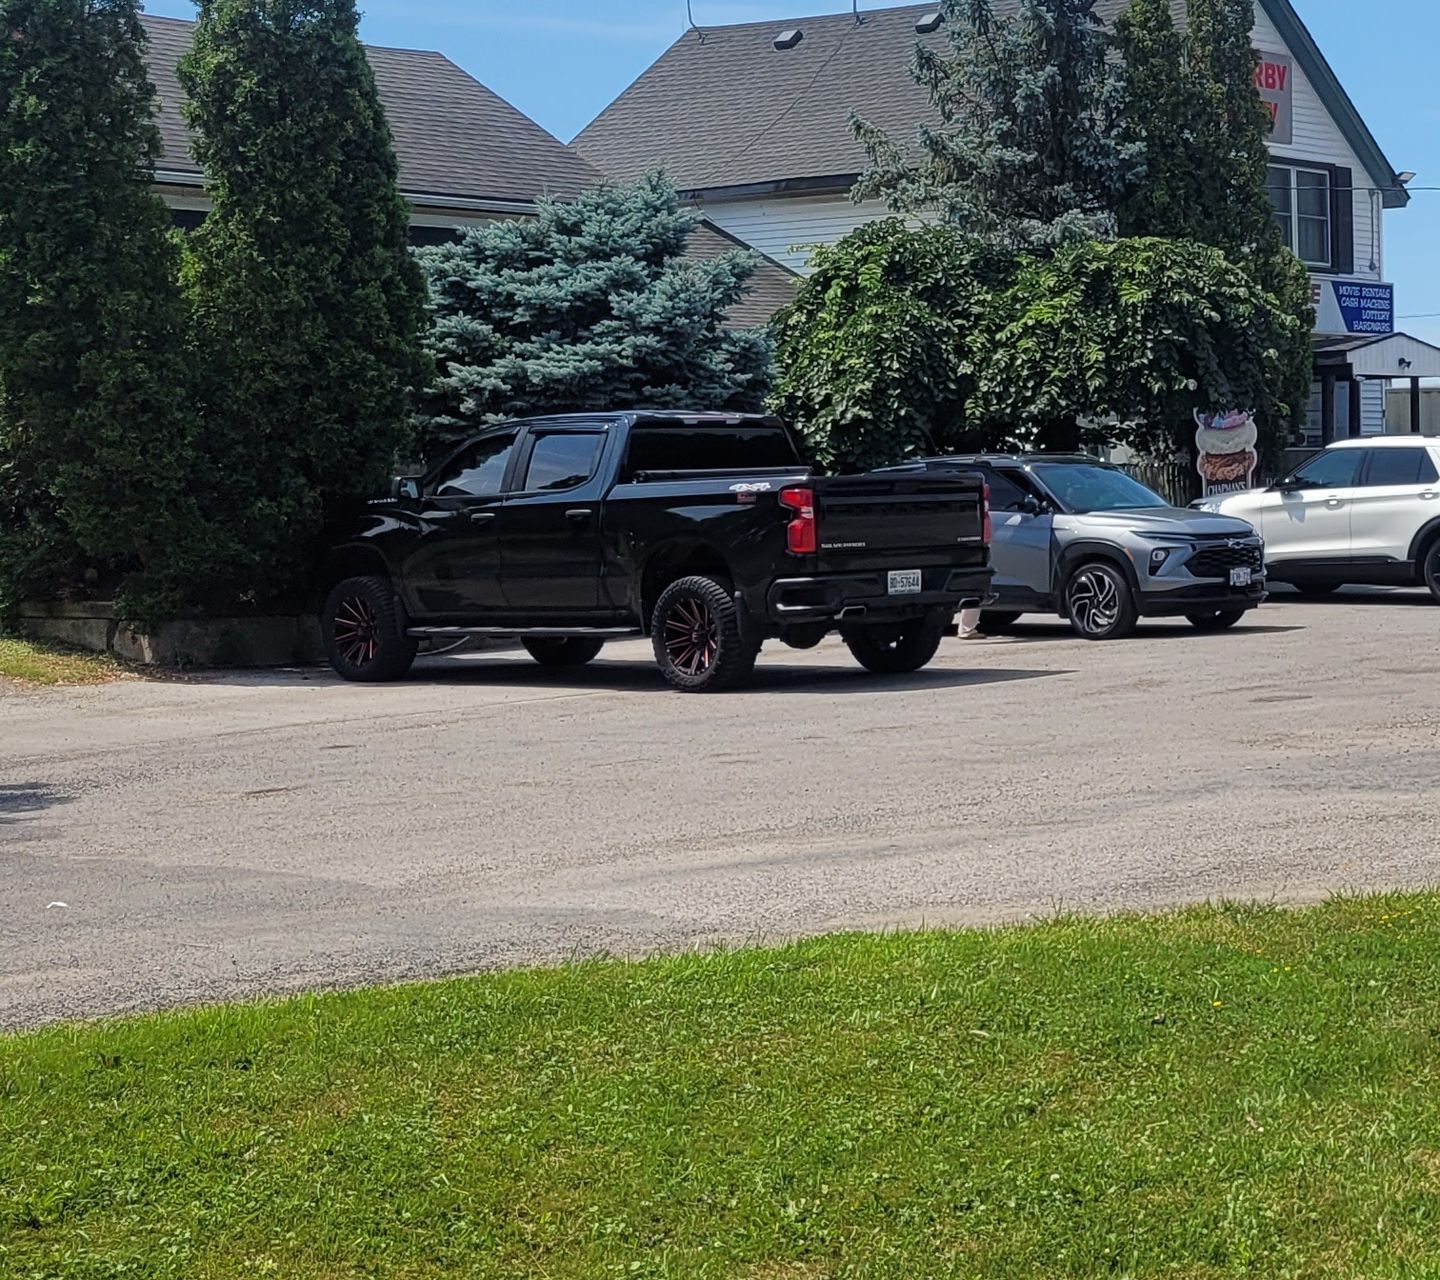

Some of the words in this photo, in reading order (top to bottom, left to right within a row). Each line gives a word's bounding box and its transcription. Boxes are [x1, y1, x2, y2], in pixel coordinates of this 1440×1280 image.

[1252, 61, 1287, 91] RBY
[1339, 285, 1360, 296] MOVIE
[1361, 287, 1391, 298] RENTALS
[1341, 296, 1359, 308] CASH
[1360, 298, 1390, 309] MACHINE
[1362, 309, 1390, 320] LOTTERY
